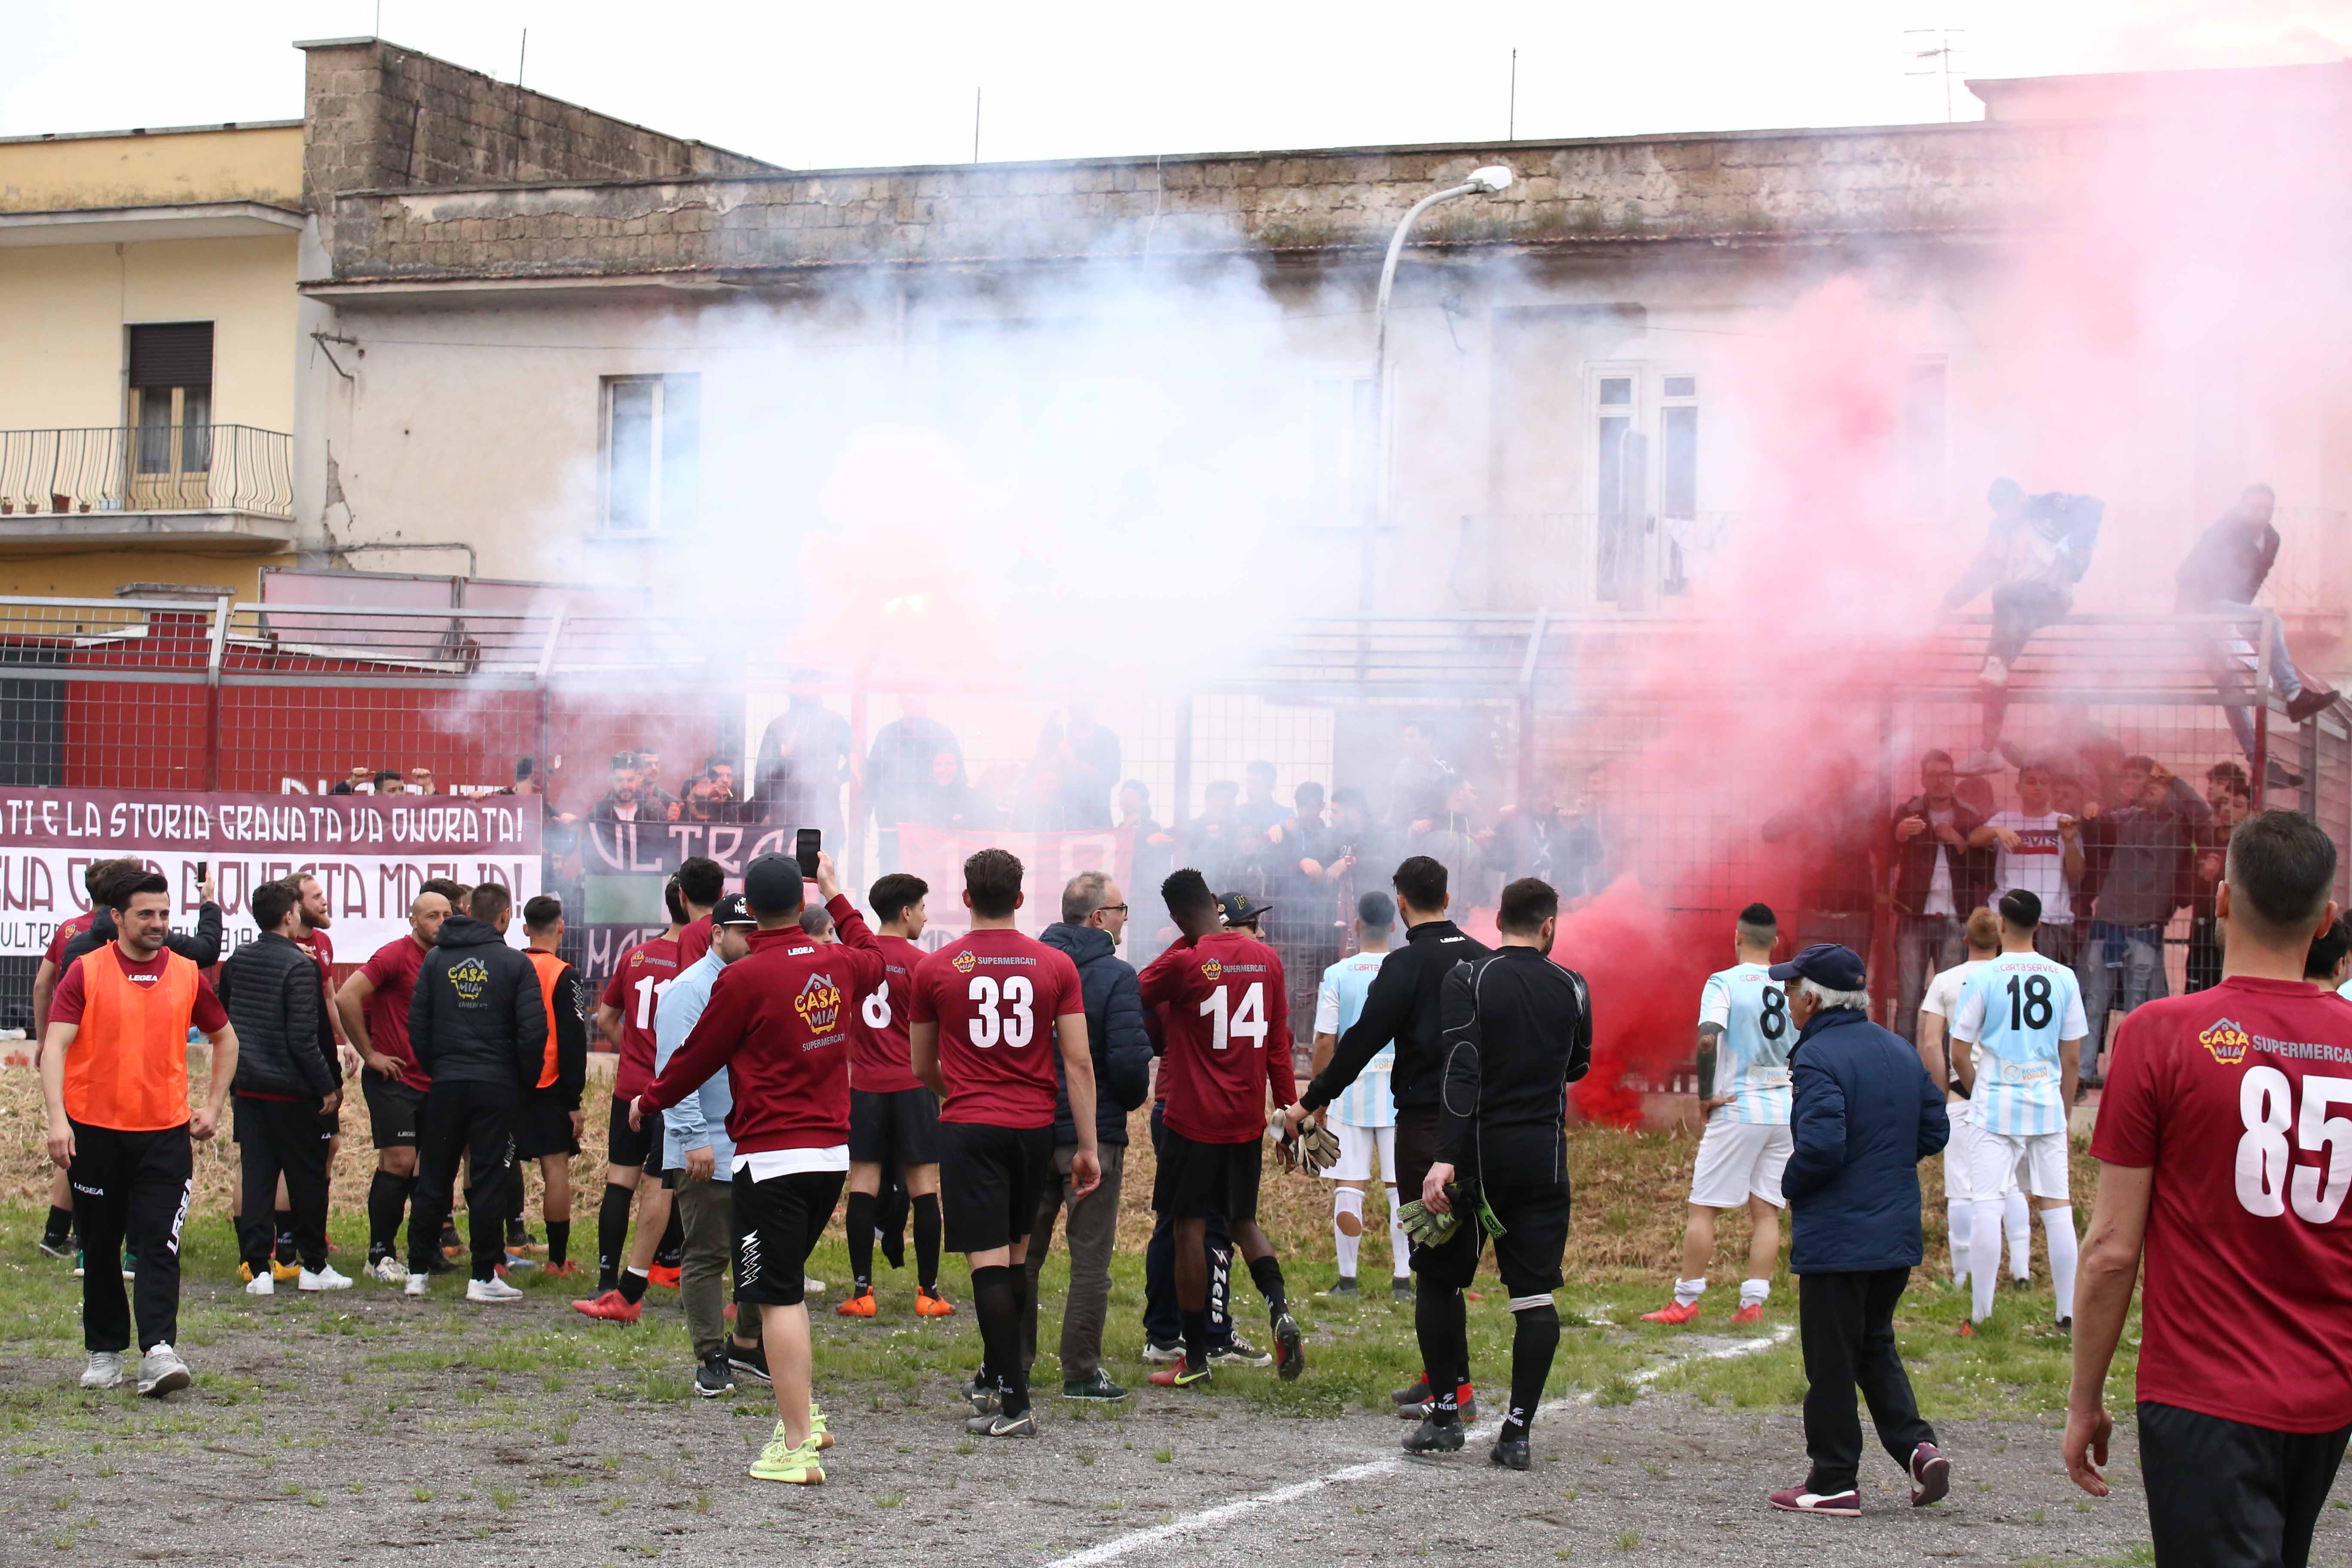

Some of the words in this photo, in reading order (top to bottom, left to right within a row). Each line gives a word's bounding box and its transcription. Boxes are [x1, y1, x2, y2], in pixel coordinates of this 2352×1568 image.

[0, 799, 33, 835] TI
[43, 800, 58, 836] E
[67, 801, 101, 837] LA
[110, 802, 210, 839] STORIA
[220, 805, 342, 842] GRANATA
[350, 808, 383, 842] VA
[392, 807, 523, 842] ONORATA!
[588, 822, 820, 875] ULTRA
[0, 855, 53, 912] NA
[218, 861, 366, 918] QUTA
[787, 946, 815, 956] LEGEA
[952, 956, 977, 965] CASA
[977, 956, 1037, 966] SUPERMERCATI
[1223, 964, 1266, 973] SUPERMERCATI
[448, 967, 488, 982] CASA
[795, 986, 841, 1012] CASA
[2007, 974, 2052, 1030] 18
[811, 1008, 836, 1027] MIA
[969, 976, 1034, 1048] 33
[1200, 982, 1269, 1049] 14
[1760, 986, 1786, 1040] 8
[802, 1033, 845, 1052] SUPERMERCATI
[2199, 1030, 2249, 1046] CASA
[2215, 1046, 2244, 1057] MIA
[2235, 1065, 2352, 1224] 85
[74, 1182, 104, 1196] LEGEA
[166, 1178, 193, 1256] LEGEA
[1212, 1265, 1227, 1324] Zeus
[1438, 1403, 1458, 1411] ZEUS
[1508, 1414, 1524, 1427] ZEUS
